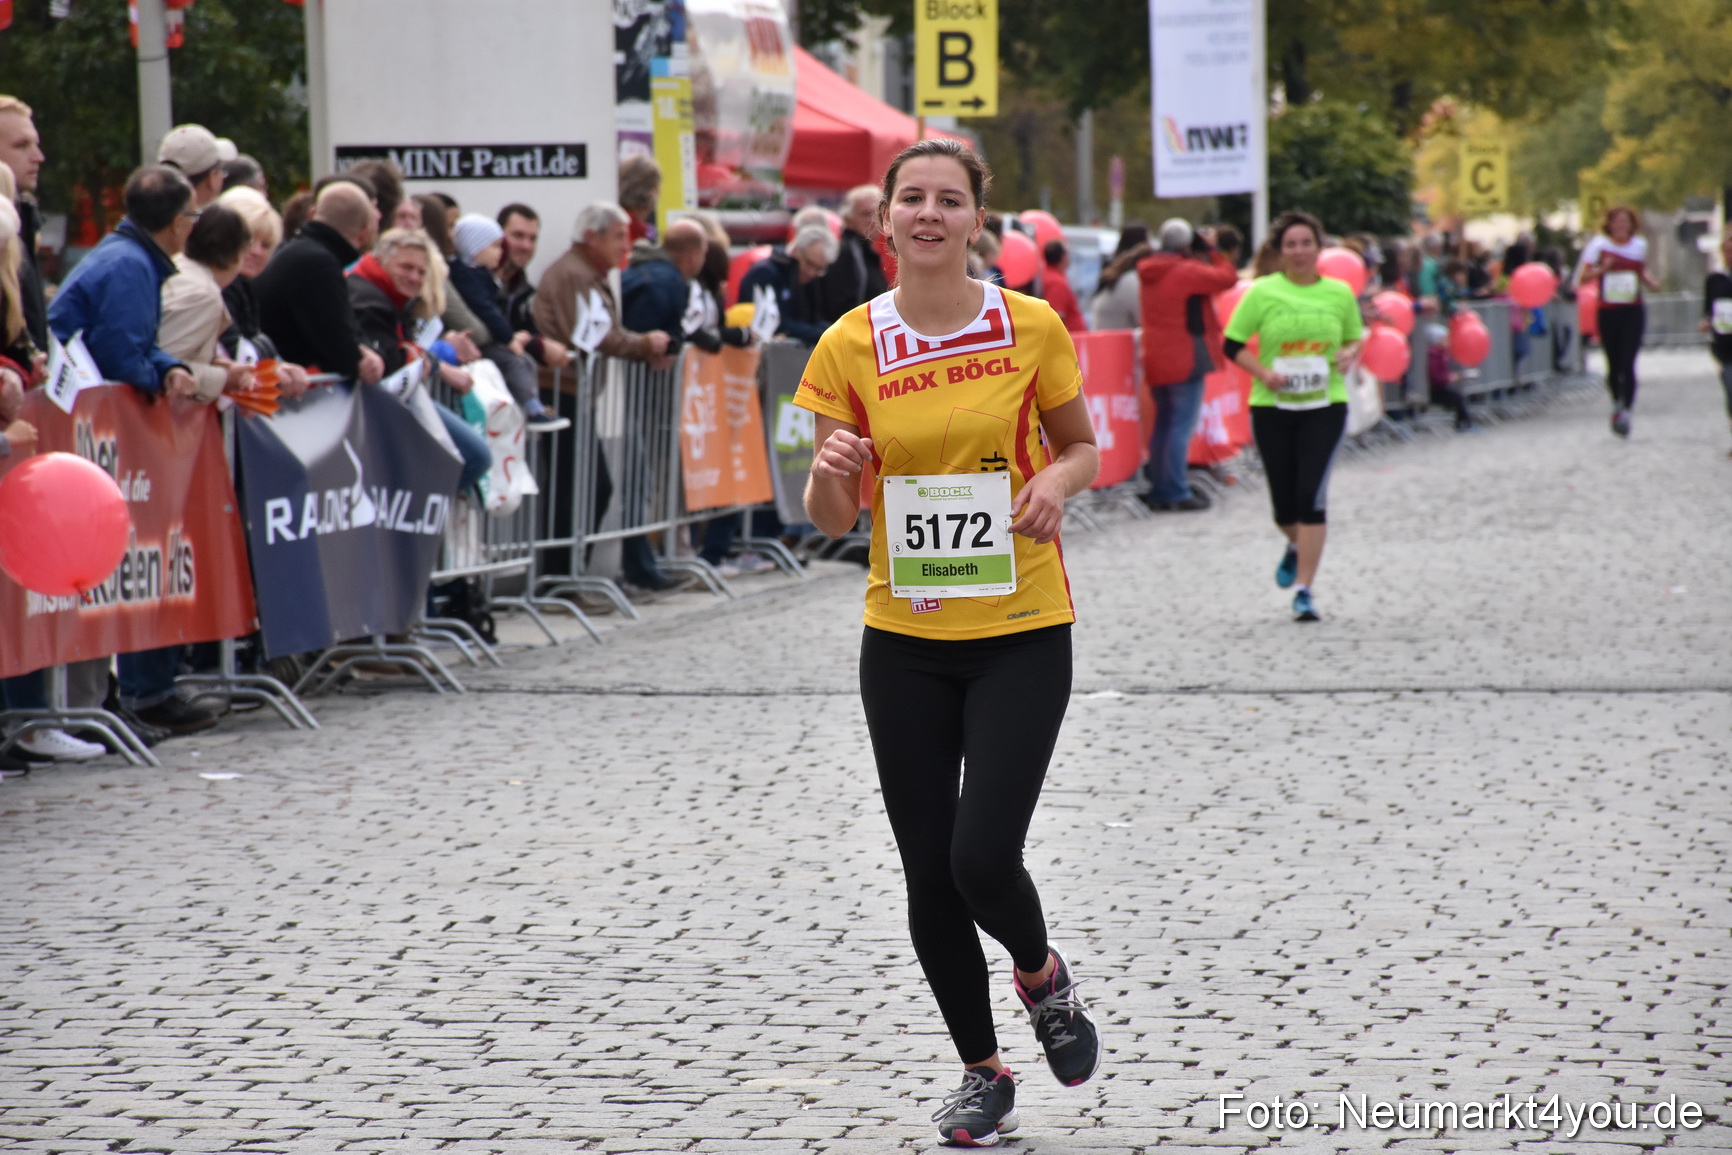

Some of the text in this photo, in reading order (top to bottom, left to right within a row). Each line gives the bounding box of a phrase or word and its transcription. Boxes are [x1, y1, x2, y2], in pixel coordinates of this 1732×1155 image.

[926, 0, 987, 20] Block
[938, 32, 976, 87] B
[1471, 161, 1494, 194] C
[878, 357, 1020, 401] MAX BÖGL
[929, 486, 973, 497] BOCK
[905, 511, 994, 550] 5172
[895, 544, 900, 552] S
[921, 562, 978, 577] Elisabeth
